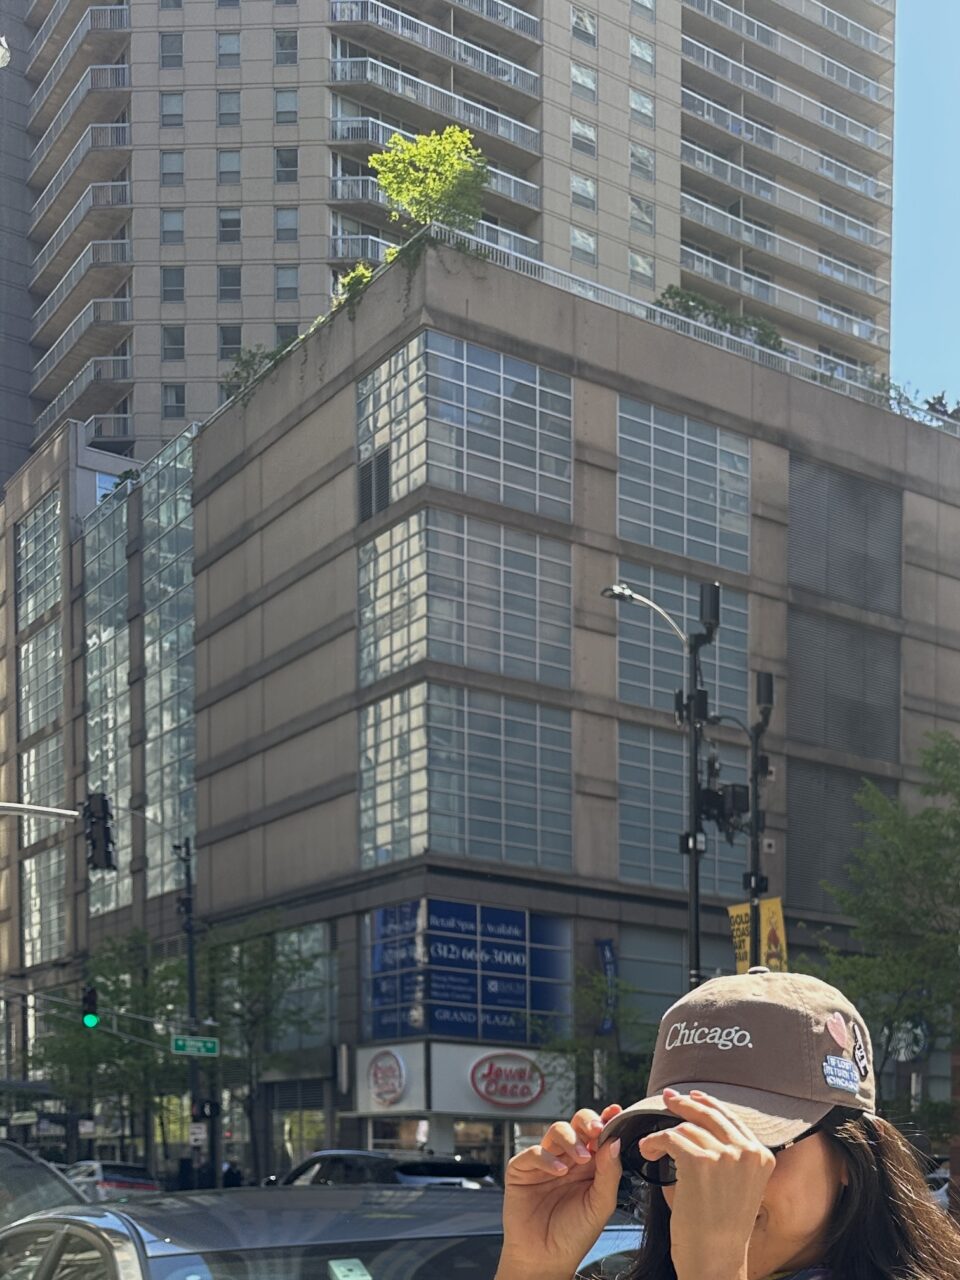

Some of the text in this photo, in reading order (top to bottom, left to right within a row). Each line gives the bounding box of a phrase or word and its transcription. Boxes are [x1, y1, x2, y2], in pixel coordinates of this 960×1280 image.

[429, 915, 456, 929] Retail
[732, 926, 750, 939] COAS
[430, 942, 460, 960] (312)
[461, 945, 526, 966] 666-3000
[434, 1008, 516, 1027] GRAND PLAZA
[665, 1022, 753, 1050] Chicago.
